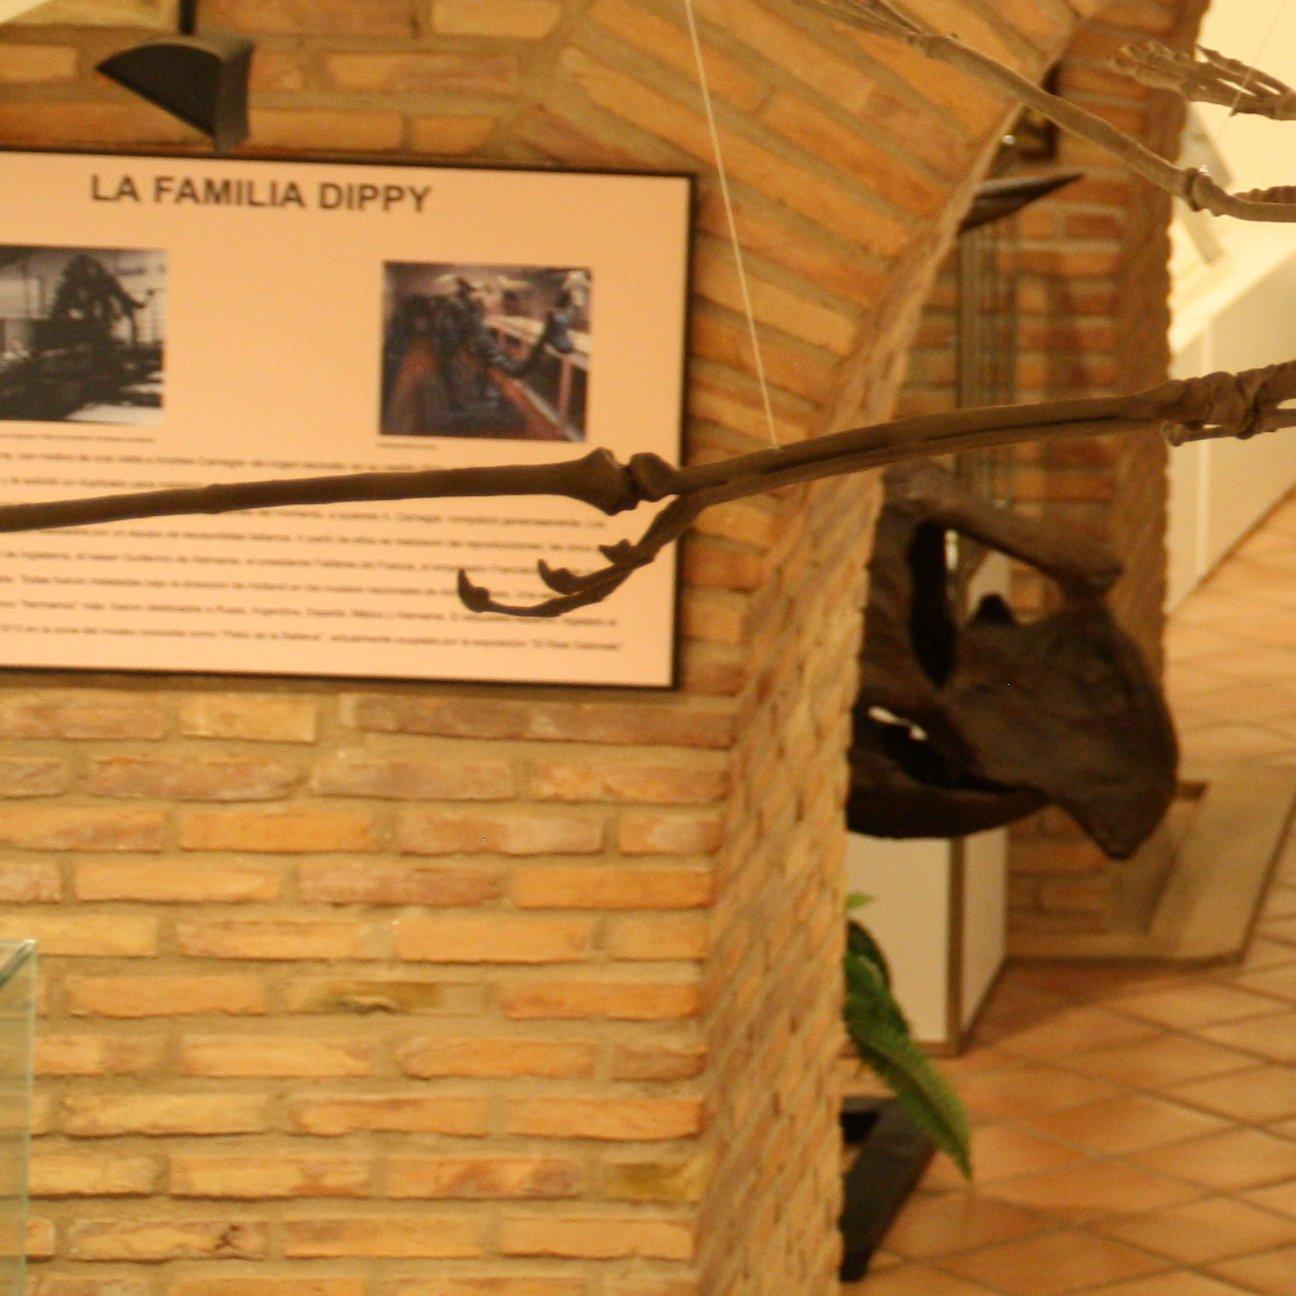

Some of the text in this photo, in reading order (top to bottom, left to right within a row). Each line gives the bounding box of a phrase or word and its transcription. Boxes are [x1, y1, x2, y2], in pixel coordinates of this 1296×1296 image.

[89, 173, 433, 214] LA FAMILIA DIPPY
